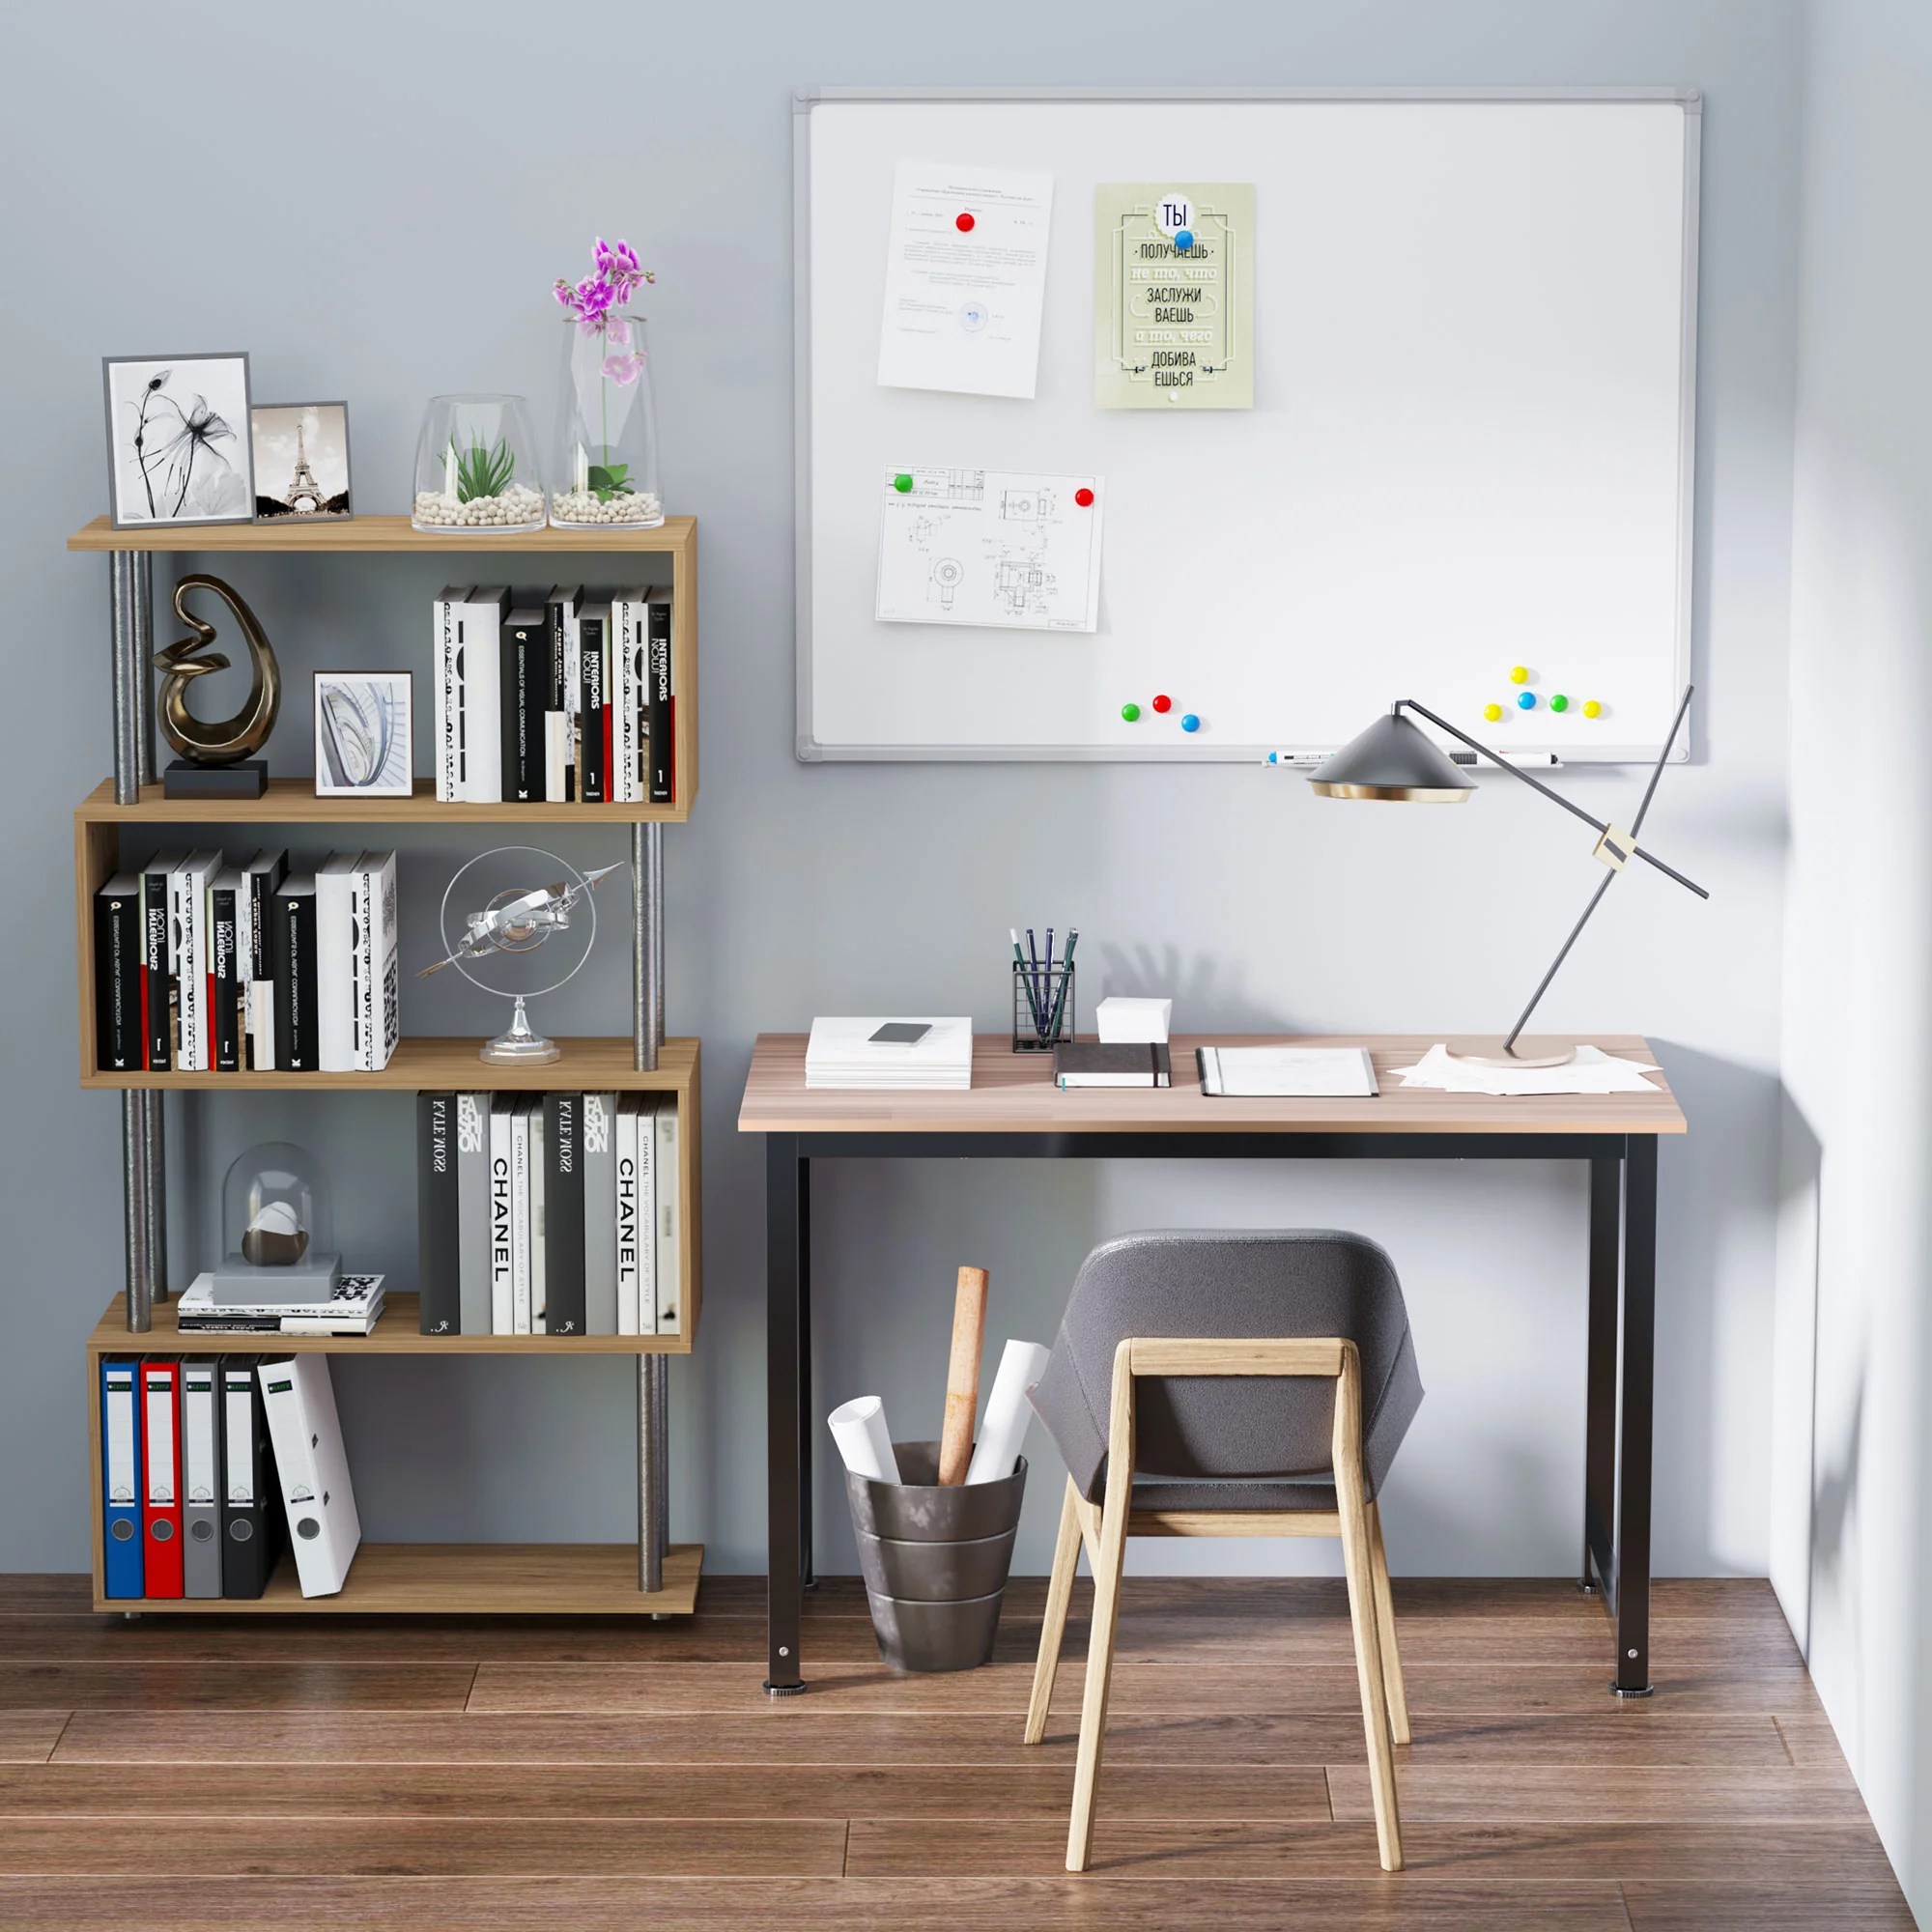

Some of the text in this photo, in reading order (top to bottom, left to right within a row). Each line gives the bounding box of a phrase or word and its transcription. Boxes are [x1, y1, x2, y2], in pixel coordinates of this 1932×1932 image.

[1163, 204, 1186, 226] ТЫ
[1141, 243, 1208, 259] ПОЛУЧАЕШЬ
[1131, 269, 1150, 280] не
[1184, 269, 1217, 280] что
[1147, 288, 1202, 302] ЗАСЛУЖИ
[1154, 307, 1194, 323] ВАЕШЬ
[1151, 352, 1197, 368] ДОБИВА
[1154, 371, 1194, 386] ЕШЬСЯ
[659, 638, 668, 702] INTERIORS
[519, 678, 526, 687] OF
[590, 650, 599, 710] INTERIORS
[590, 772, 595, 785] 1
[658, 769, 663, 783] 1
[494, 1158, 509, 1282] CHANEL
[619, 1158, 635, 1282] CHANEL
